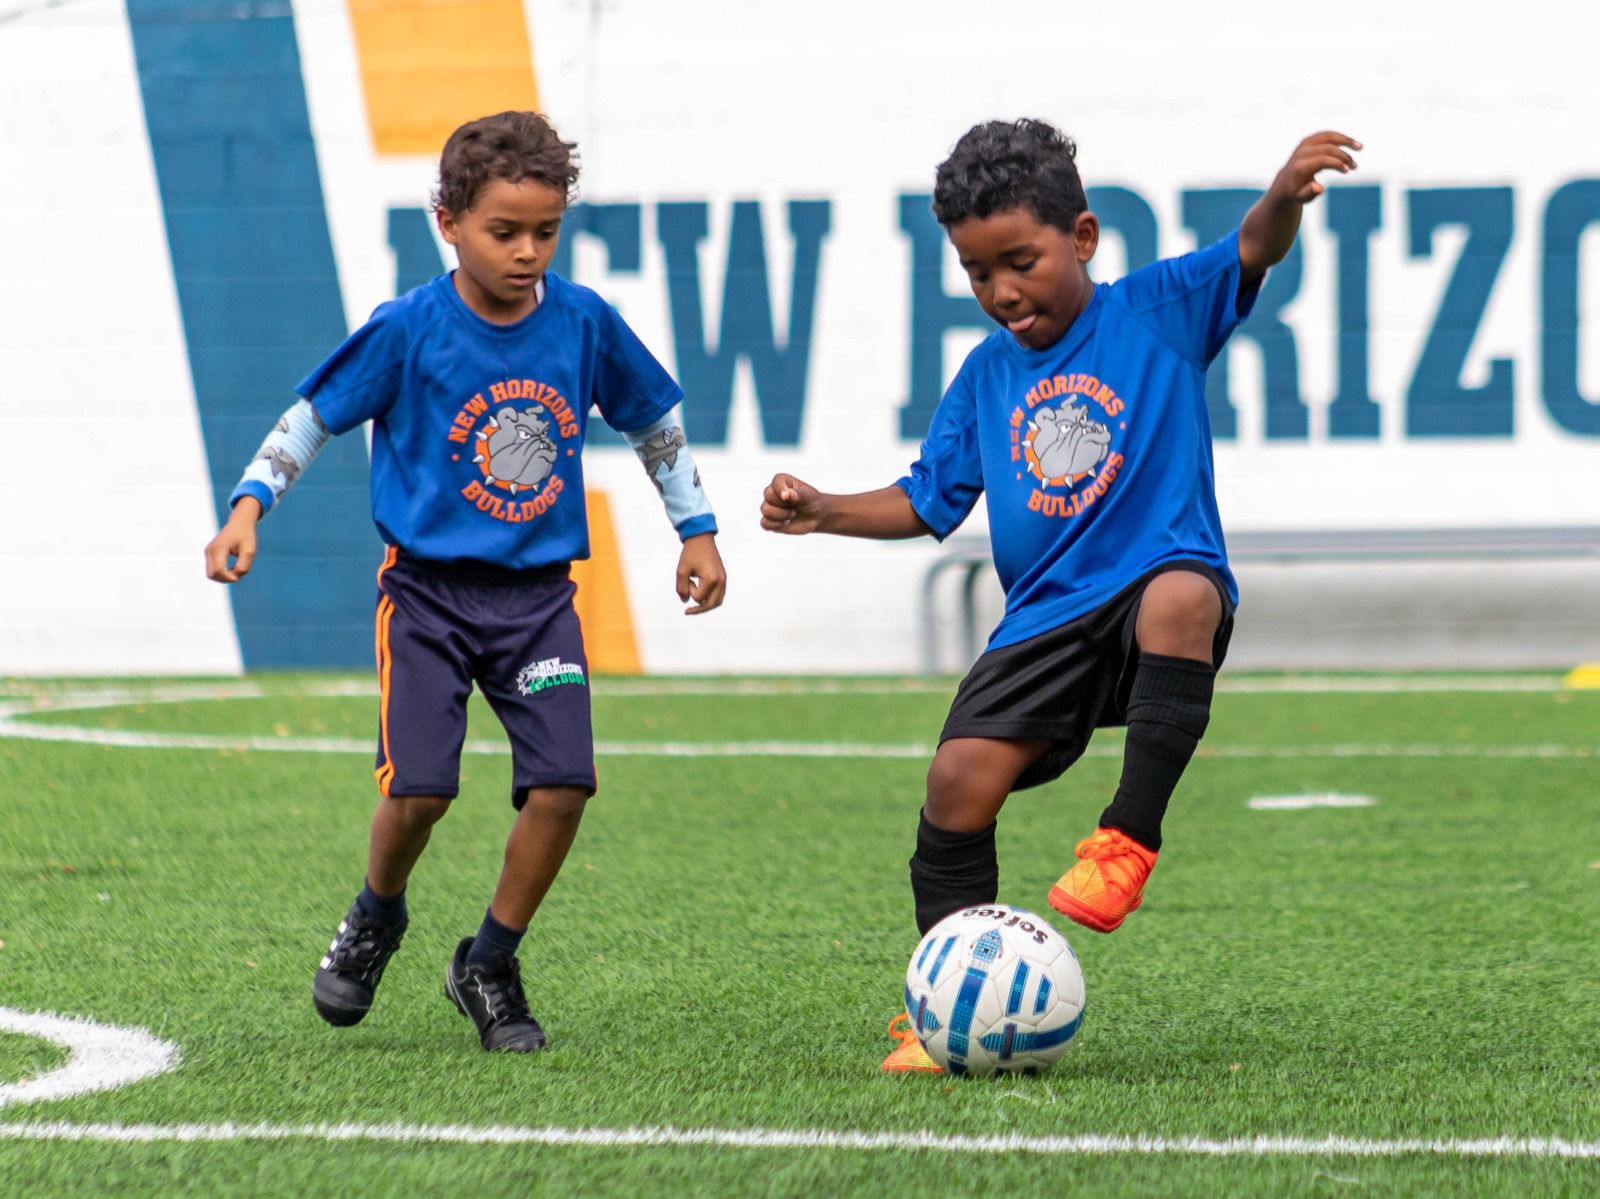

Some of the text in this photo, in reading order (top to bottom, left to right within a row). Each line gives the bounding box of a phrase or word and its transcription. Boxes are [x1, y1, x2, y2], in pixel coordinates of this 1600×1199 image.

[448, 379, 579, 444] NEW HORIZONS
[1010, 373, 1125, 462] NEW HORIZONS
[461, 474, 564, 522] BULLDOGS
[1026, 451, 1125, 518] BULLDOGS
